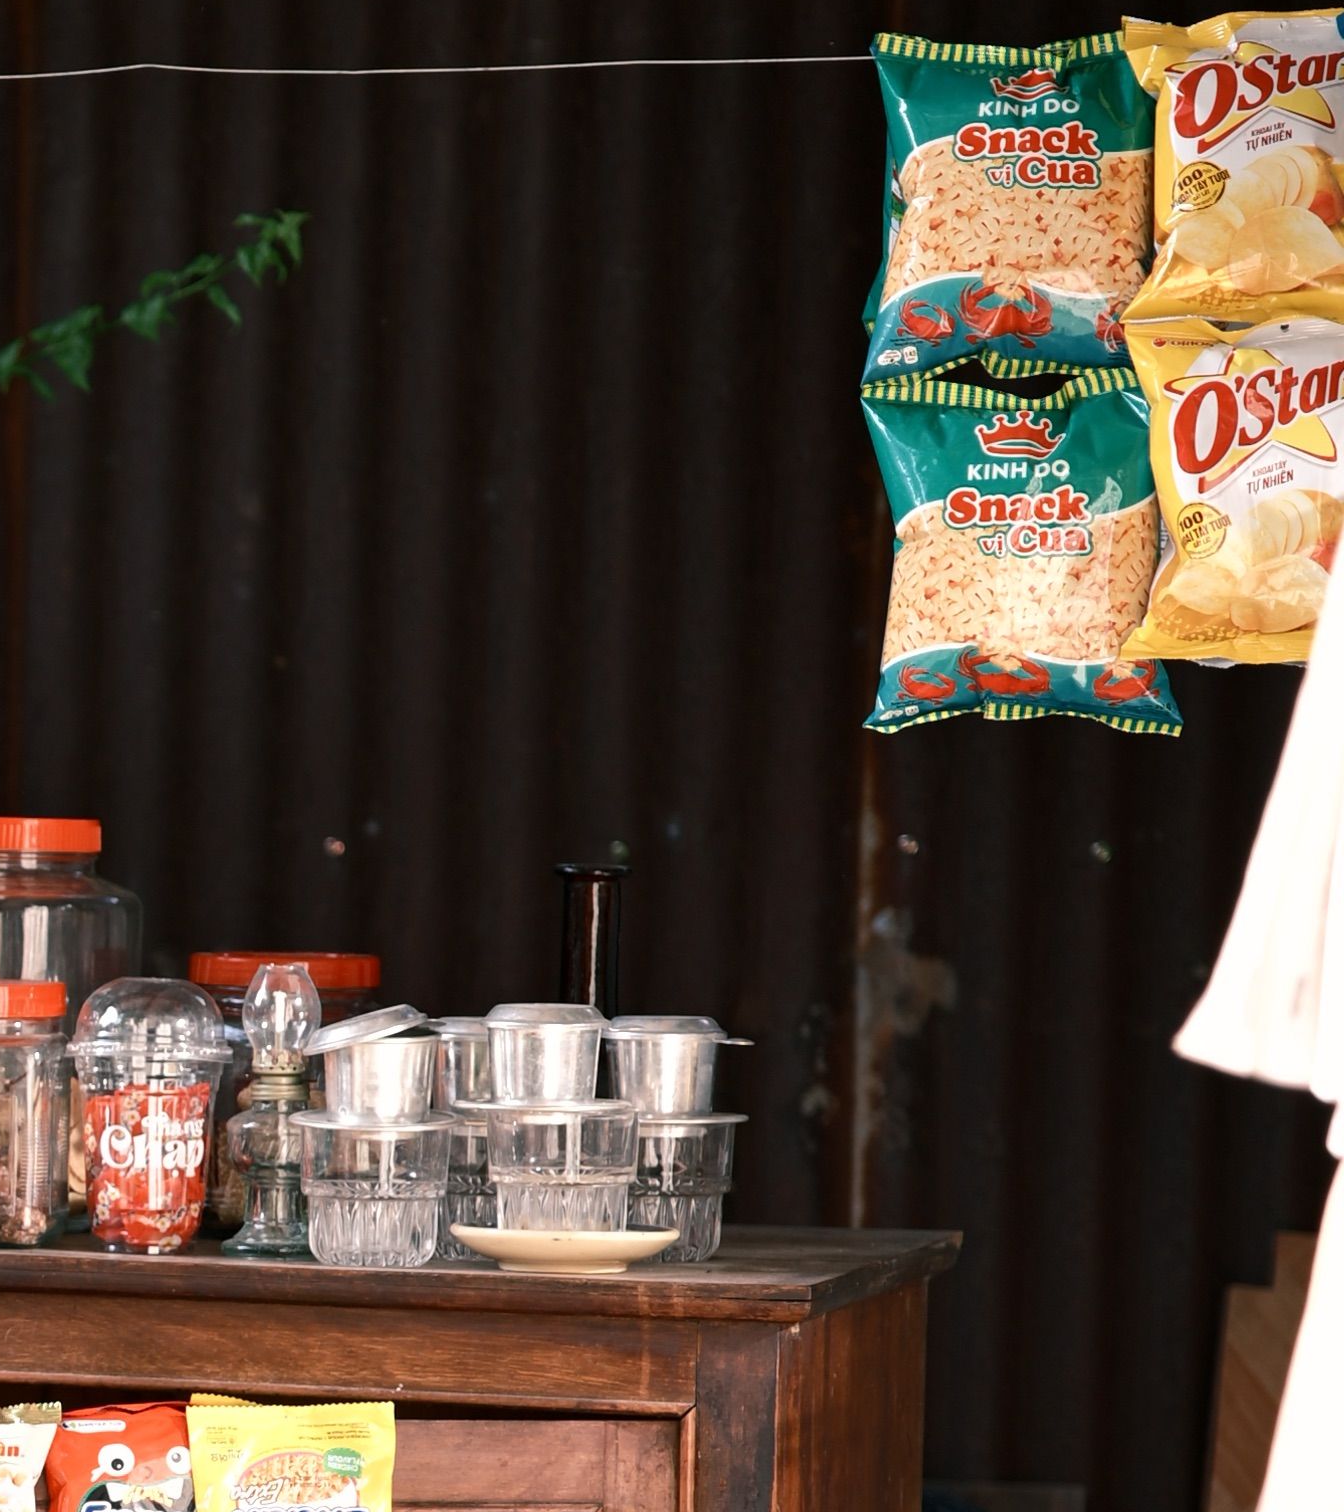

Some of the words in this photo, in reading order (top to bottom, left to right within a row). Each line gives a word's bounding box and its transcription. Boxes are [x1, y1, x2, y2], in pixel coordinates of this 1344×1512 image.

[978, 100, 1038, 118] KINH
[1043, 98, 1081, 114] DO
[957, 122, 1098, 157] Snack
[988, 165, 1012, 186] vị
[1017, 156, 1097, 185] Cua
[1173, 361, 1344, 475] O'Star
[967, 461, 1028, 481] KINH
[1033, 459, 1071, 478] DO
[1262, 469, 1295, 490] NHIÊN
[947, 487, 1088, 525] Snack
[981, 535, 1003, 556] vị
[1011, 525, 1088, 554] Cua
